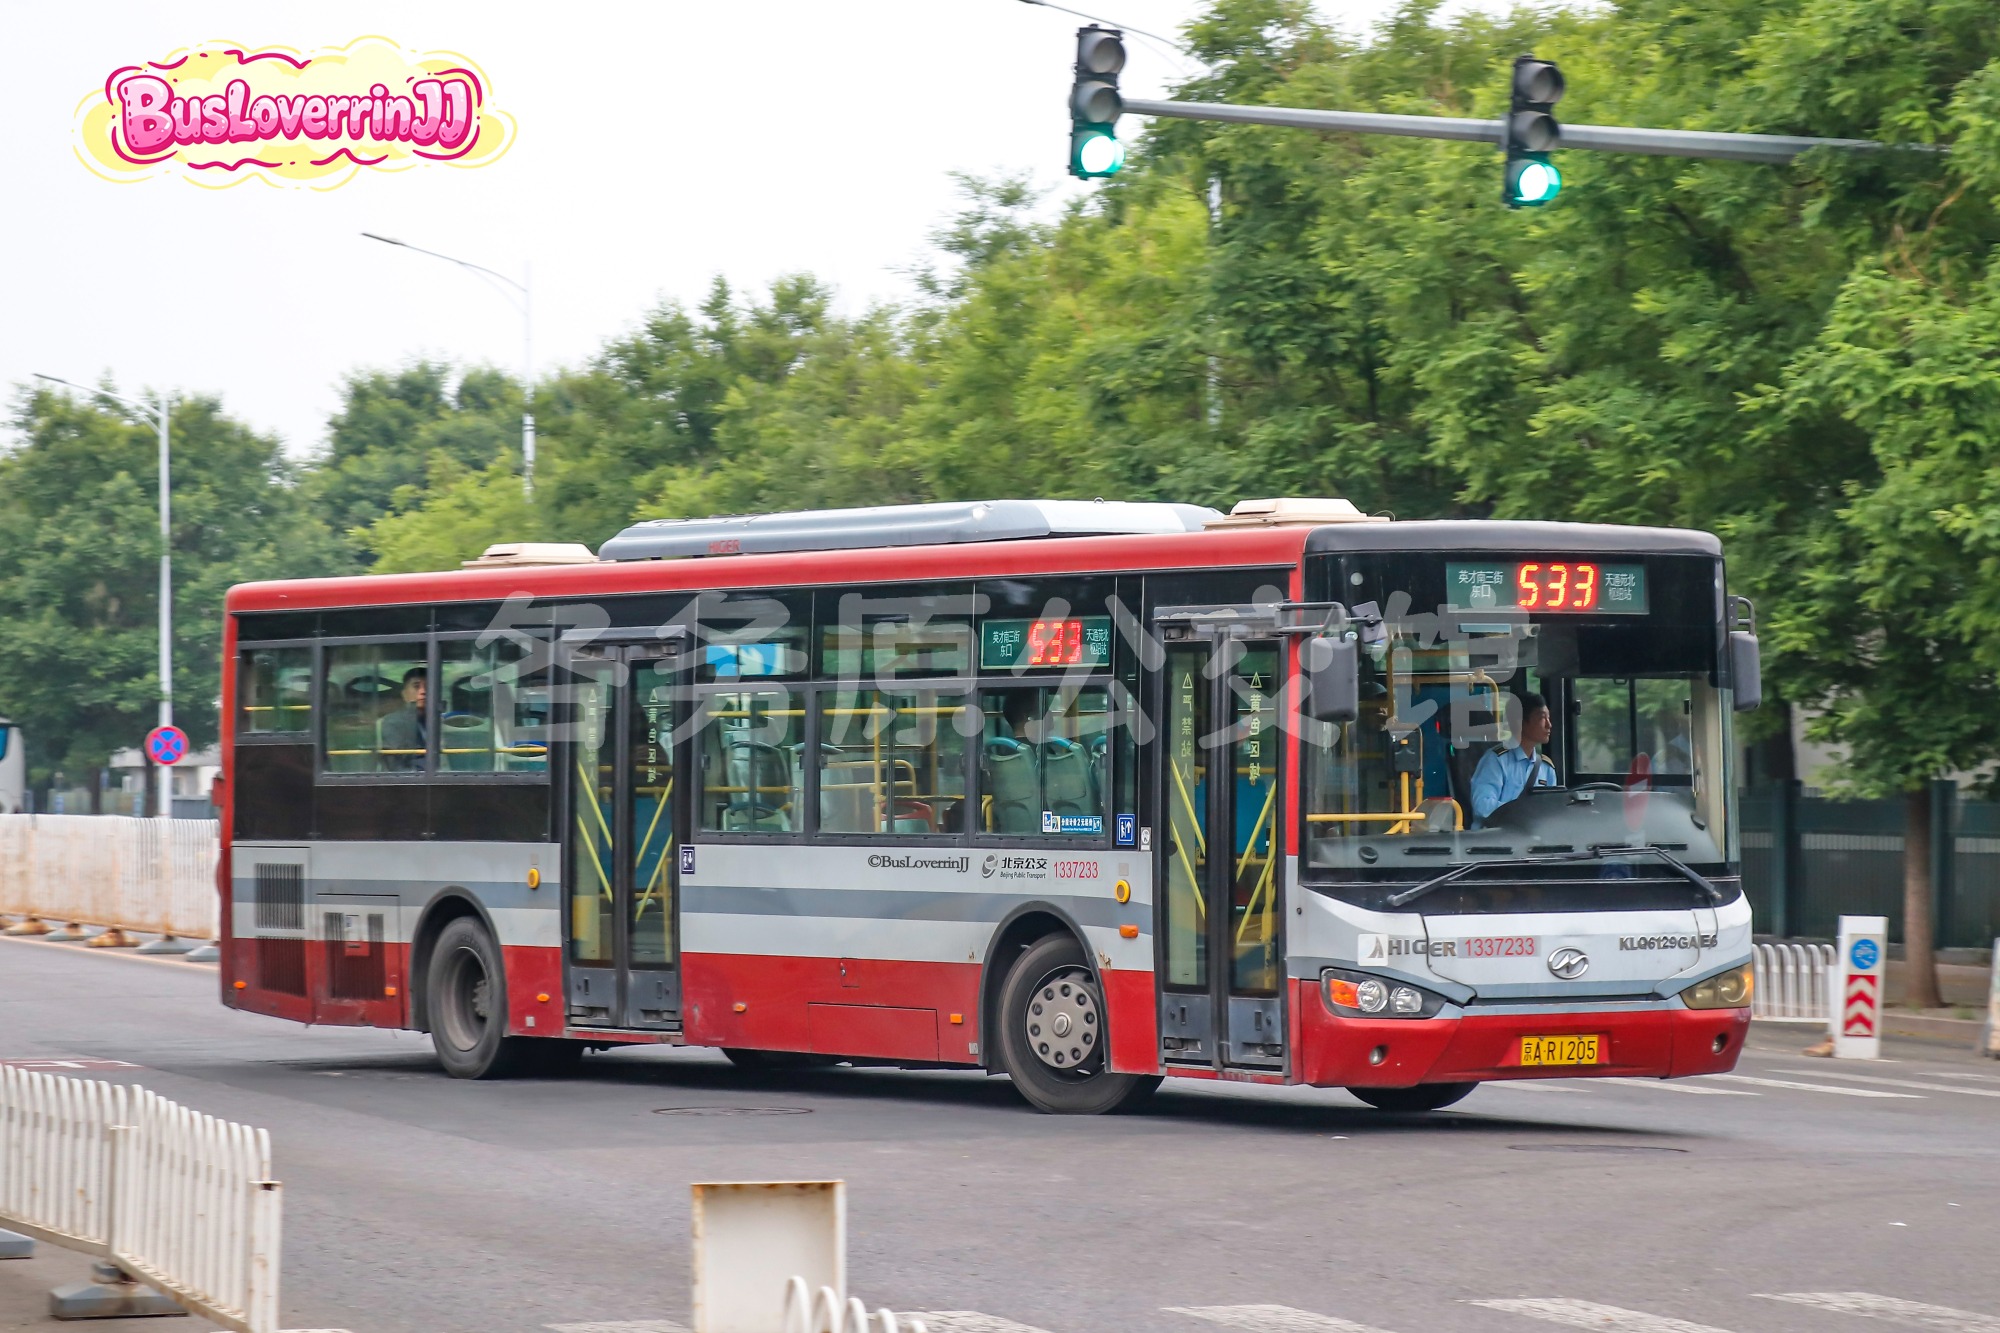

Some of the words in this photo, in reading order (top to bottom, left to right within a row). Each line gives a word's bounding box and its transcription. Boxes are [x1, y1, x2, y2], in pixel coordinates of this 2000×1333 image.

[1458, 570, 1504, 585] 英才南三街
[1605, 573, 1636, 587] 天通苑北
[1471, 585, 1491, 599] 东口
[1518, 564, 1595, 607] 533
[992, 630, 1021, 644] 英才南三街
[1031, 622, 1081, 662] 533
[1001, 857, 1048, 870] 北京公交
[1053, 861, 1099, 879] 1337233
[1026, 872, 1046, 880] Transport
[1388, 939, 1457, 957] HIGER
[1465, 937, 1535, 957] 1337233
